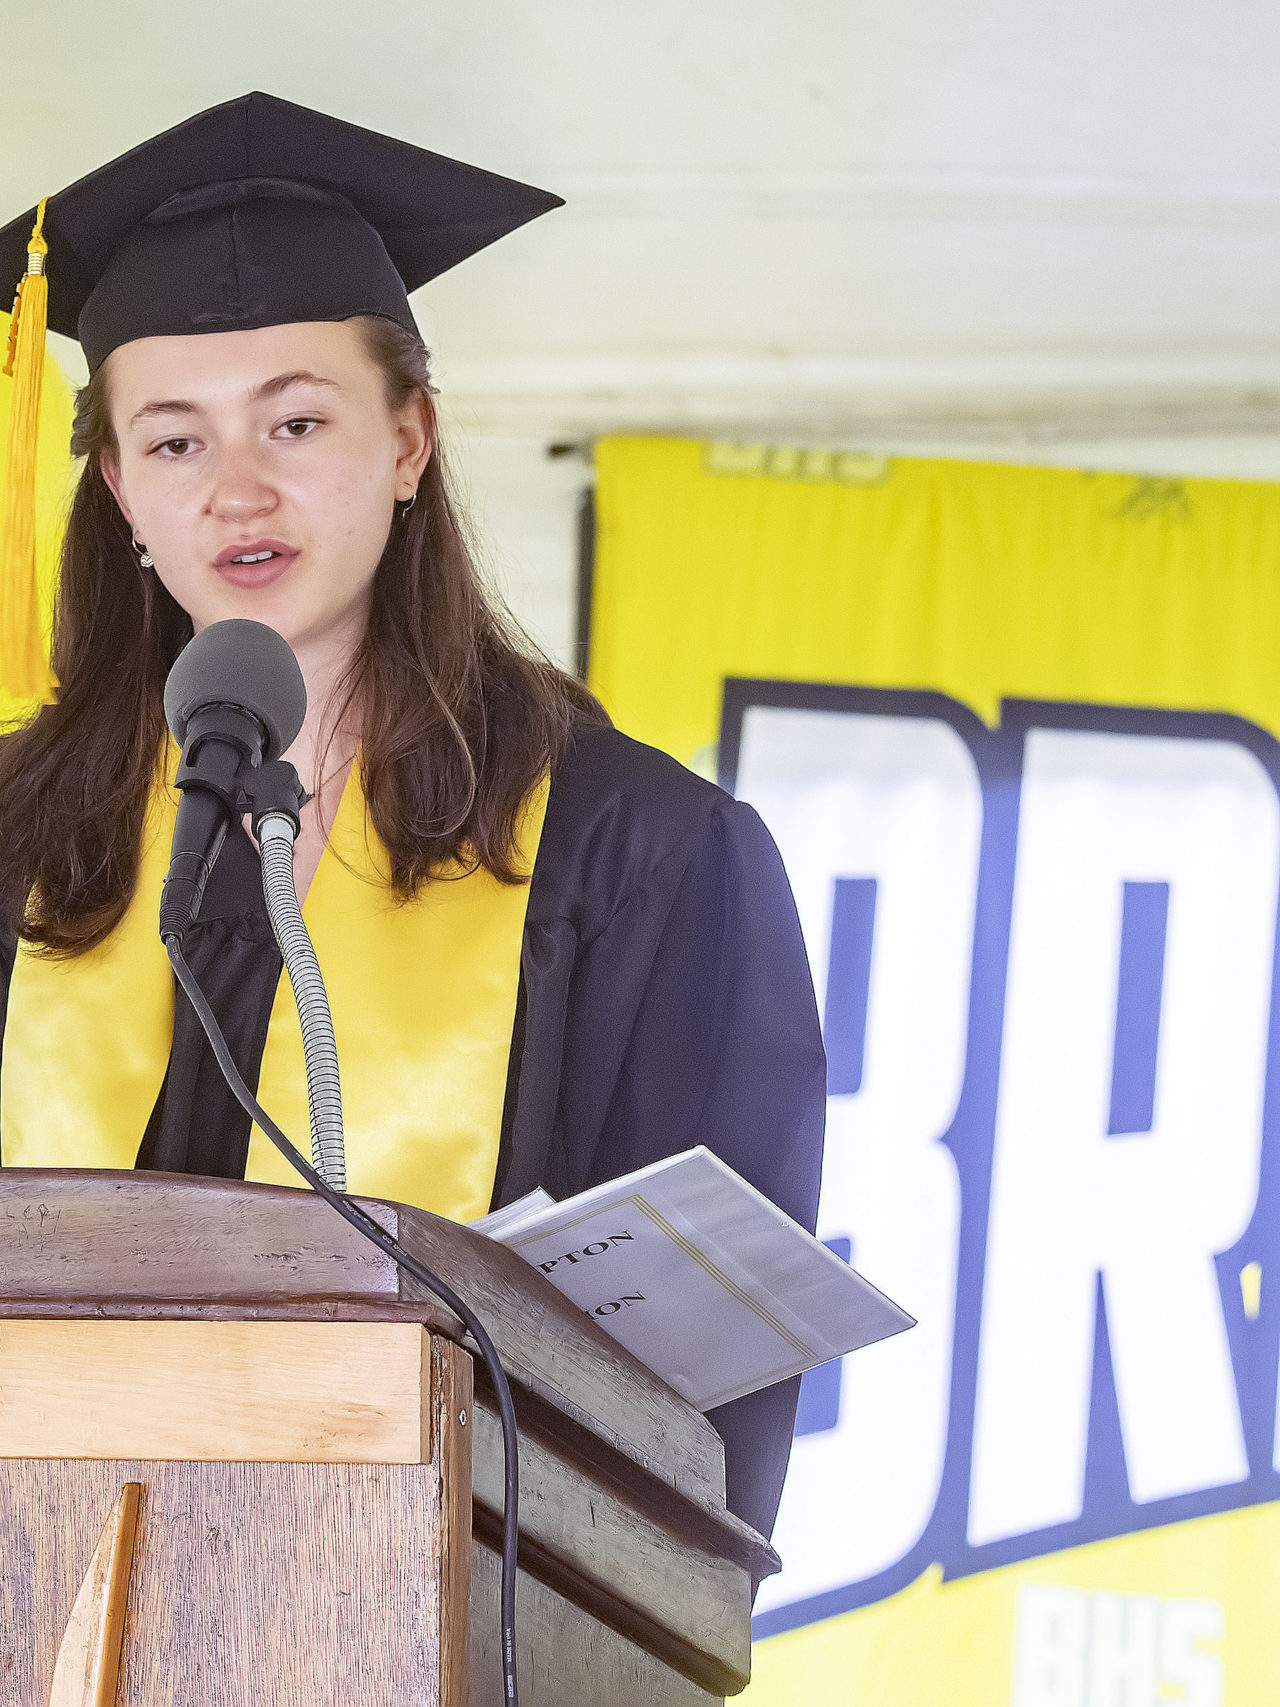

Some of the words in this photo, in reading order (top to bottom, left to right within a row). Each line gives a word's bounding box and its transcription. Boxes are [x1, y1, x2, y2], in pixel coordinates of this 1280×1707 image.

[723, 680, 1280, 1636] BR
[539, 1230, 635, 1275] PTON
[1013, 1582, 1223, 1707] BHS
